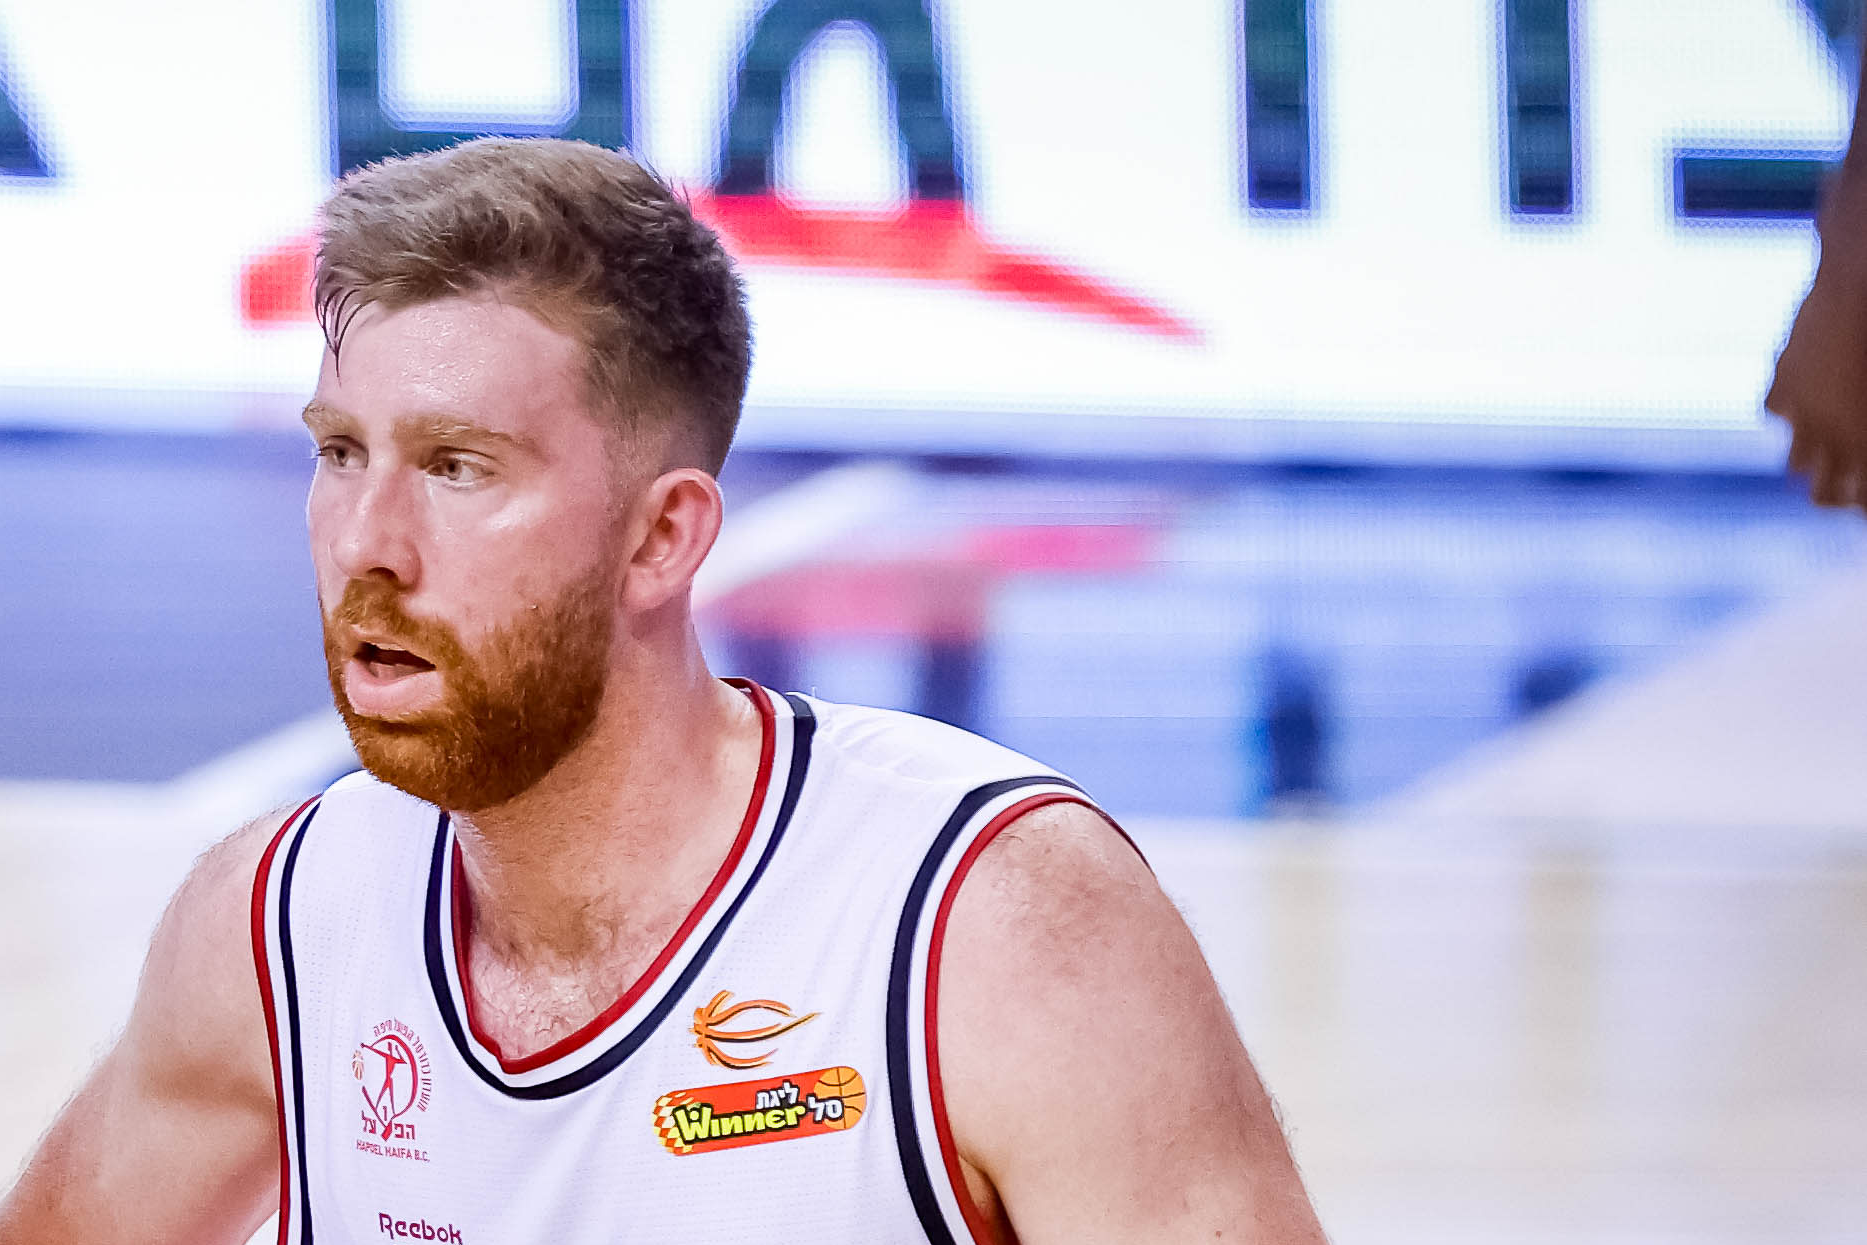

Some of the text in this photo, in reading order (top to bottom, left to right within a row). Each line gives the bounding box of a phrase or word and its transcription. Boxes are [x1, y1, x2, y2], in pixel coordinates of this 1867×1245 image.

[757, 1082, 799, 1109] ליגת
[675, 1096, 843, 1141] Winner סל
[356, 1139, 384, 1156] HAPOEL
[384, 1146, 413, 1160] HAIFA
[379, 1212, 463, 1245] Reebok
